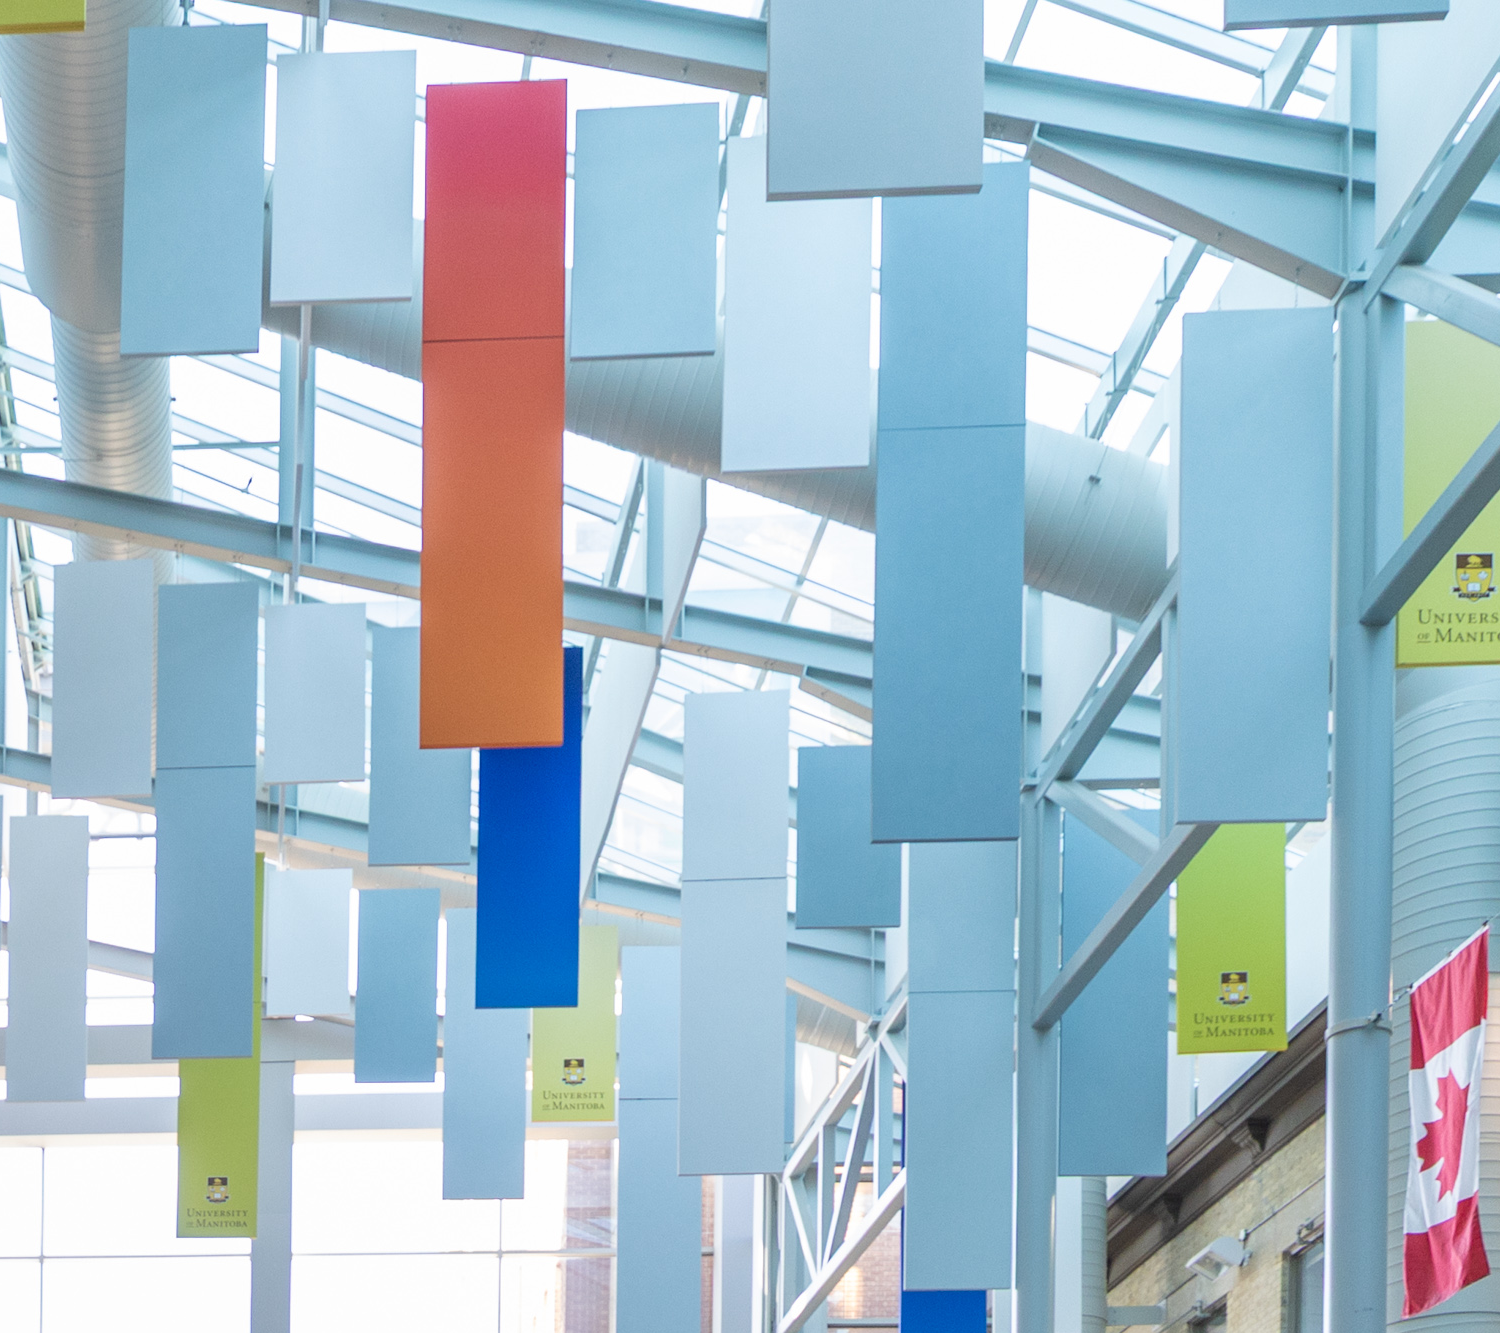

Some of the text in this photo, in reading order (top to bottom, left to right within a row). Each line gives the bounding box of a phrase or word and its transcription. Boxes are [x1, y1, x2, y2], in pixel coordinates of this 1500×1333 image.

[1193, 1012, 1275, 1024] UNIVERSITY
[1205, 1026, 1275, 1038] MANITOBA
[542, 1090, 605, 1100] UNIVERSITY
[552, 1101, 605, 1110] MANITOBA
[186, 1208, 249, 1218] UNIVERSITY
[196, 1219, 248, 1228] MANITOBA
